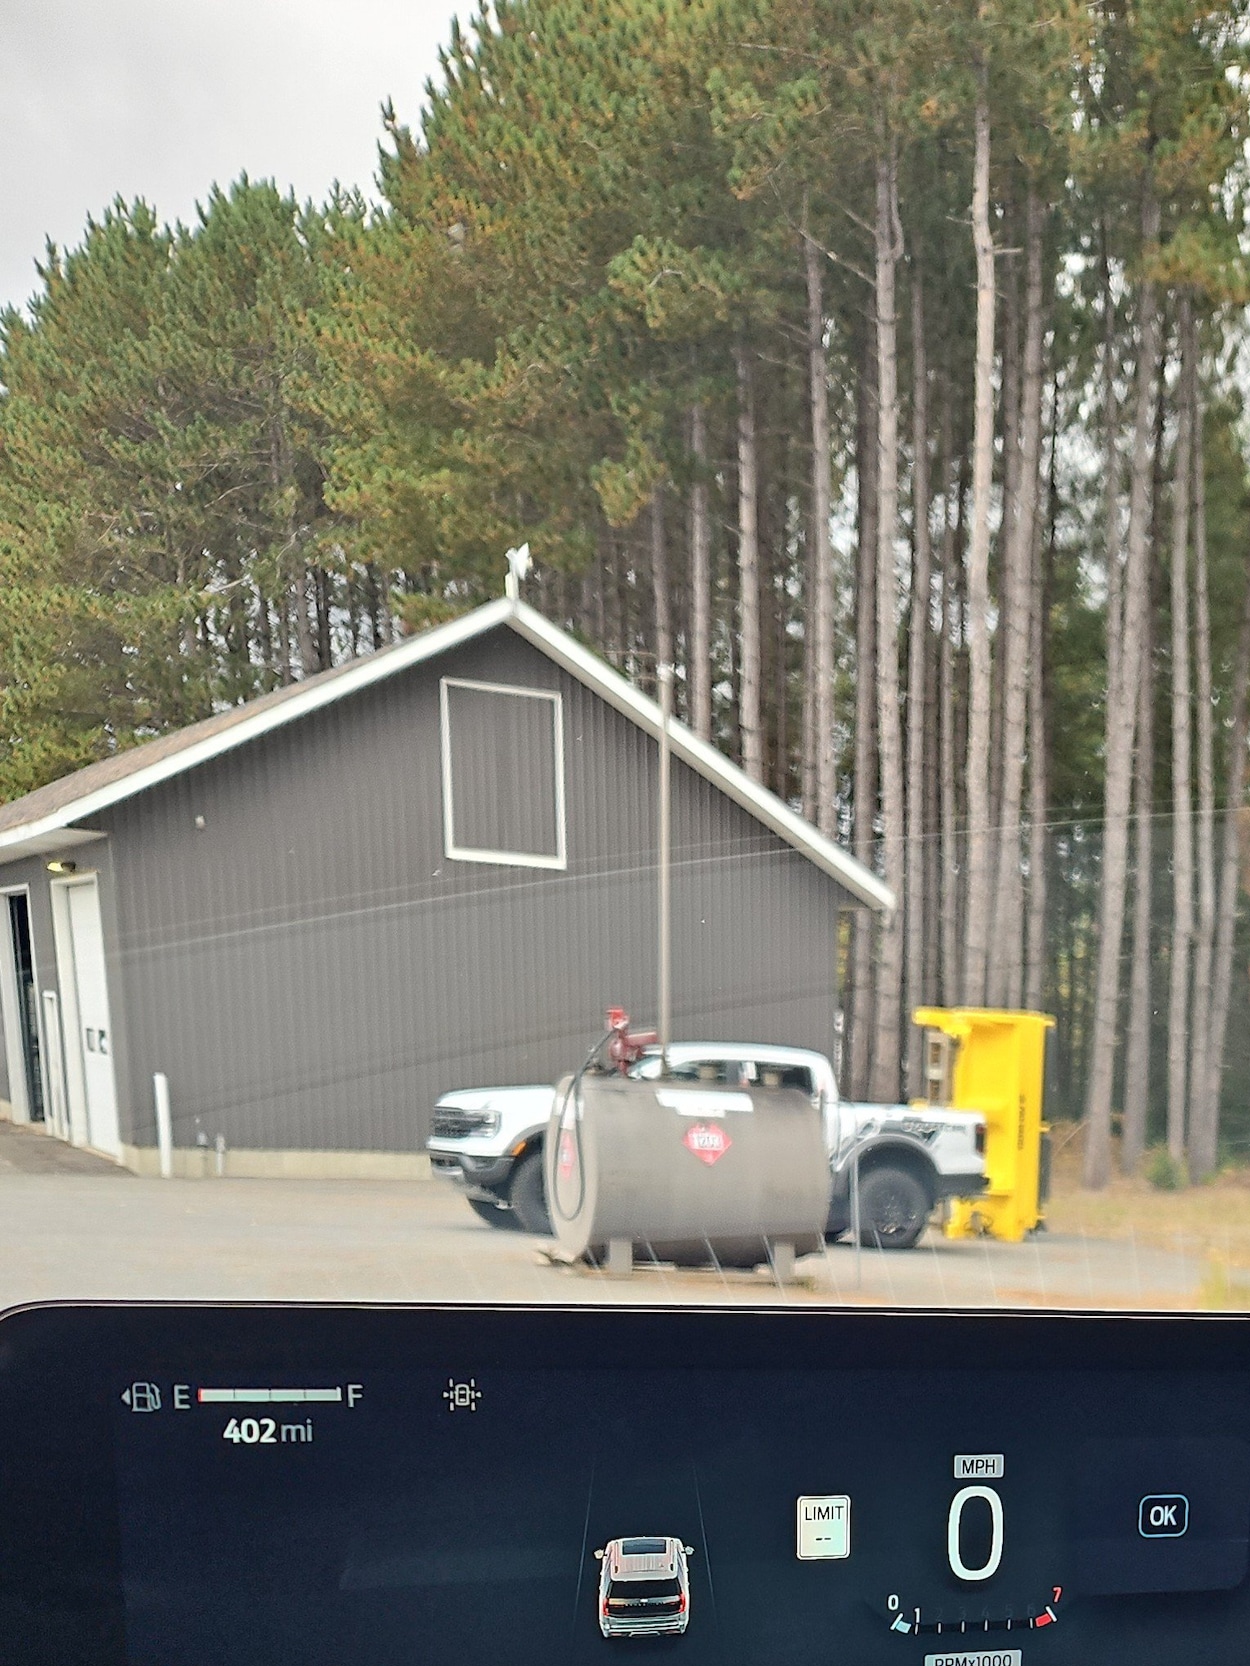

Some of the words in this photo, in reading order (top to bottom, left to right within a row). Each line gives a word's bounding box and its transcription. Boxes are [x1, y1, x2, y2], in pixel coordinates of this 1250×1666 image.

[172, 1384, 191, 1410] E
[346, 1384, 363, 1408] F
[961, 1459, 997, 1476] MPH
[804, 1505, 845, 1522] LIMIT
[1149, 1505, 1177, 1527] OK
[947, 1485, 1004, 1581] 0
[887, 1594, 899, 1611] 0
[914, 1607, 921, 1623] 1
[1053, 1586, 1063, 1602] 7
